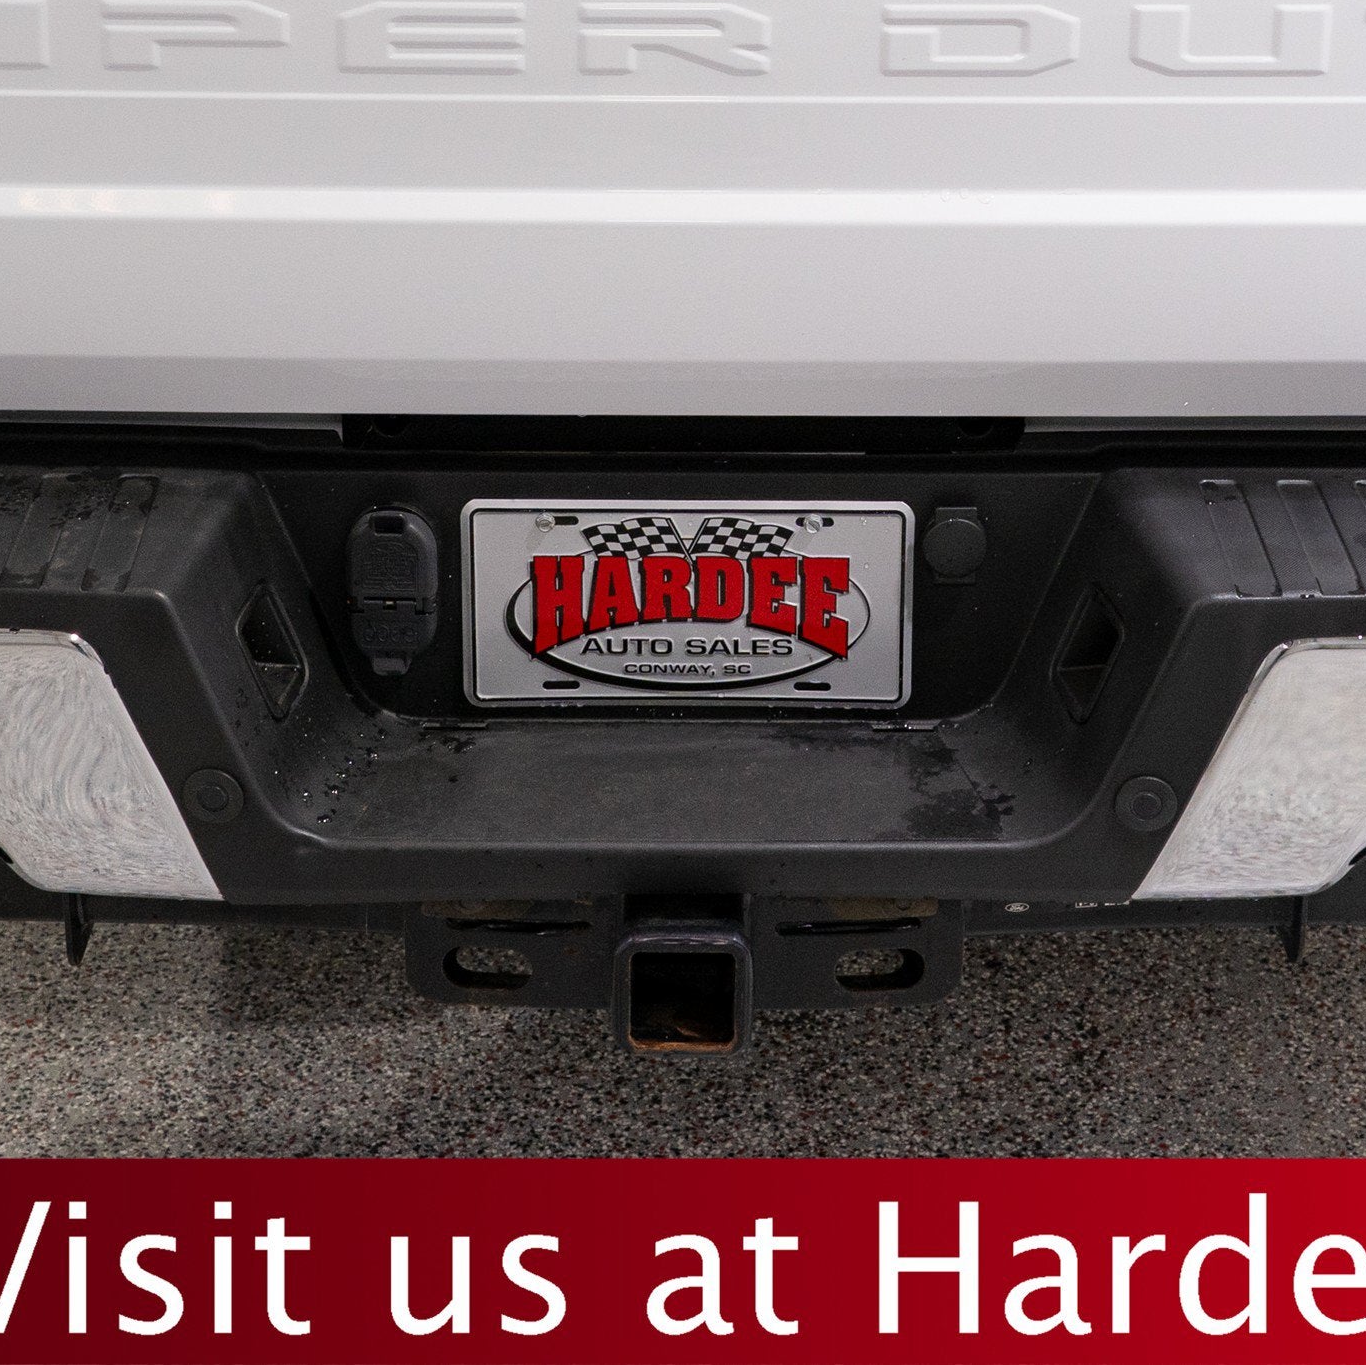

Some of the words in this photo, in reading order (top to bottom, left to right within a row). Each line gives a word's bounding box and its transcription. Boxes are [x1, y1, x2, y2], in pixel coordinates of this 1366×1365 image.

[530, 555, 851, 660] HARDEE
[580, 637, 674, 656] AUTO
[684, 637, 794, 657] SALES
[624, 663, 716, 677] CONWAY,
[723, 663, 752, 675] SC
